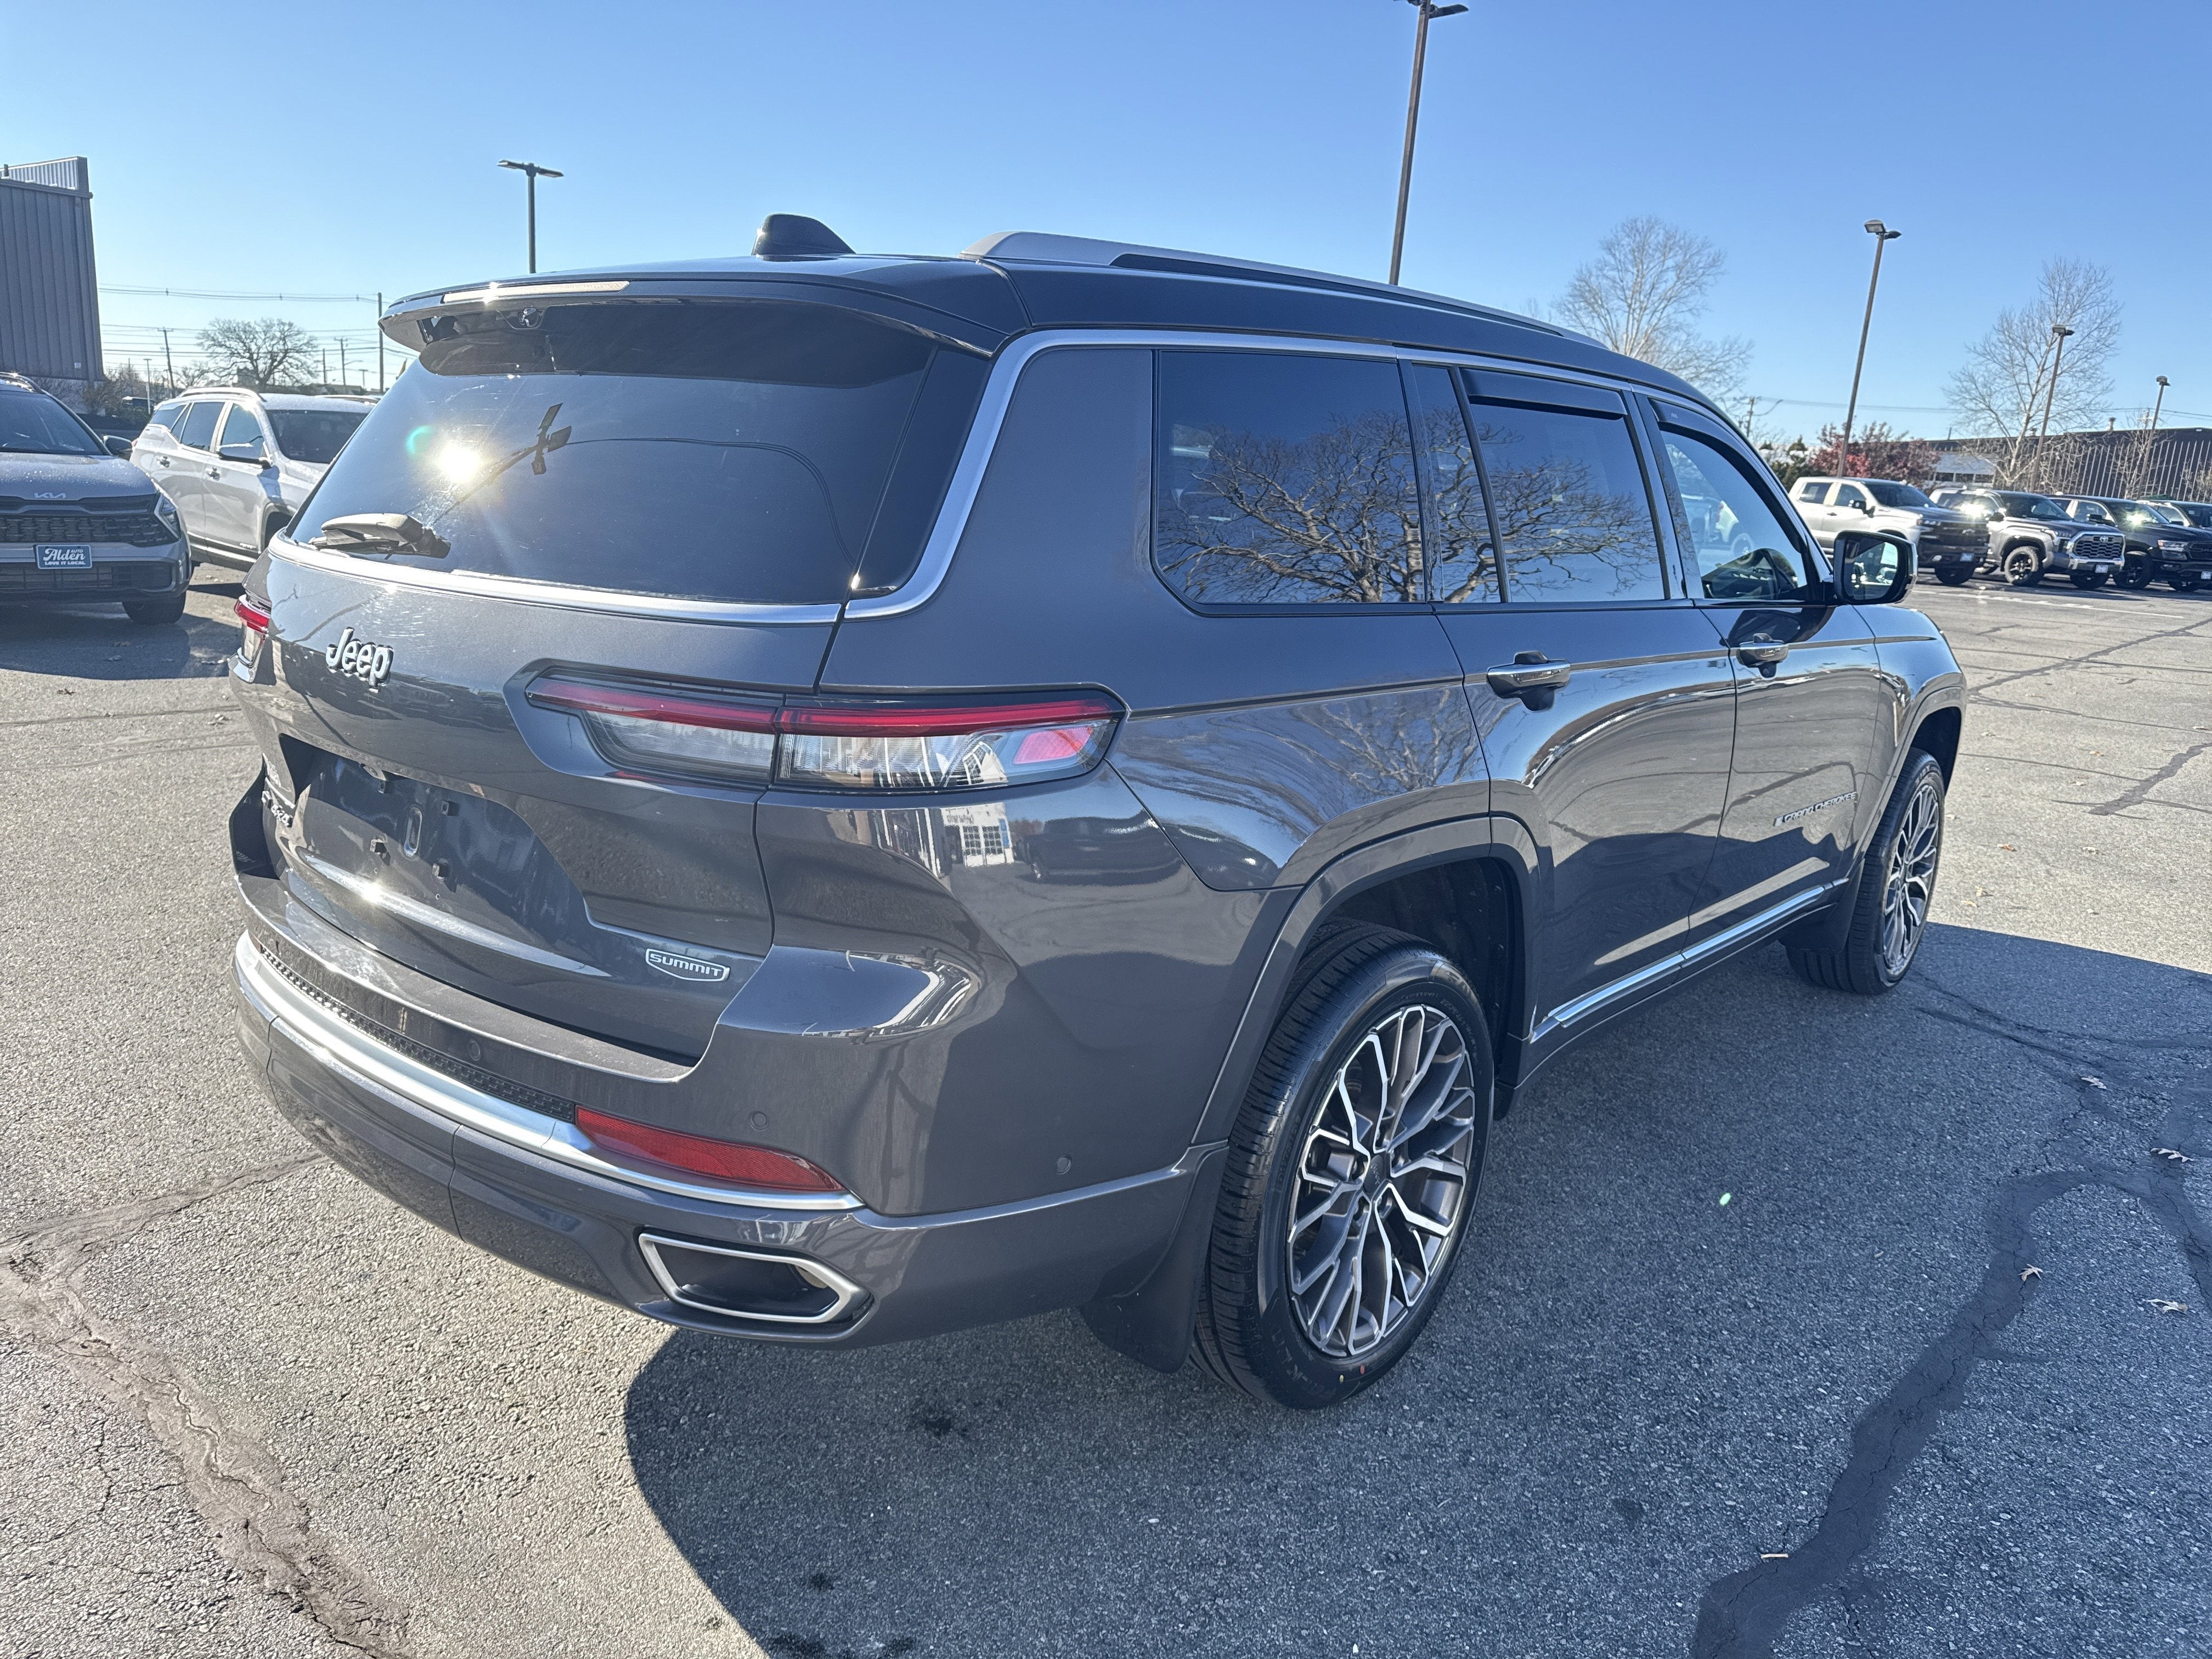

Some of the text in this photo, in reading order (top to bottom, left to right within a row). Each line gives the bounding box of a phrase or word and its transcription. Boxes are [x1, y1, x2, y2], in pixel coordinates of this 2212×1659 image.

[43, 548, 86, 561] Alden
[325, 627, 394, 687] Jeep
[1784, 791, 1857, 823] GRAND CHEROKEE
[649, 953, 722, 977] SUMMIT
